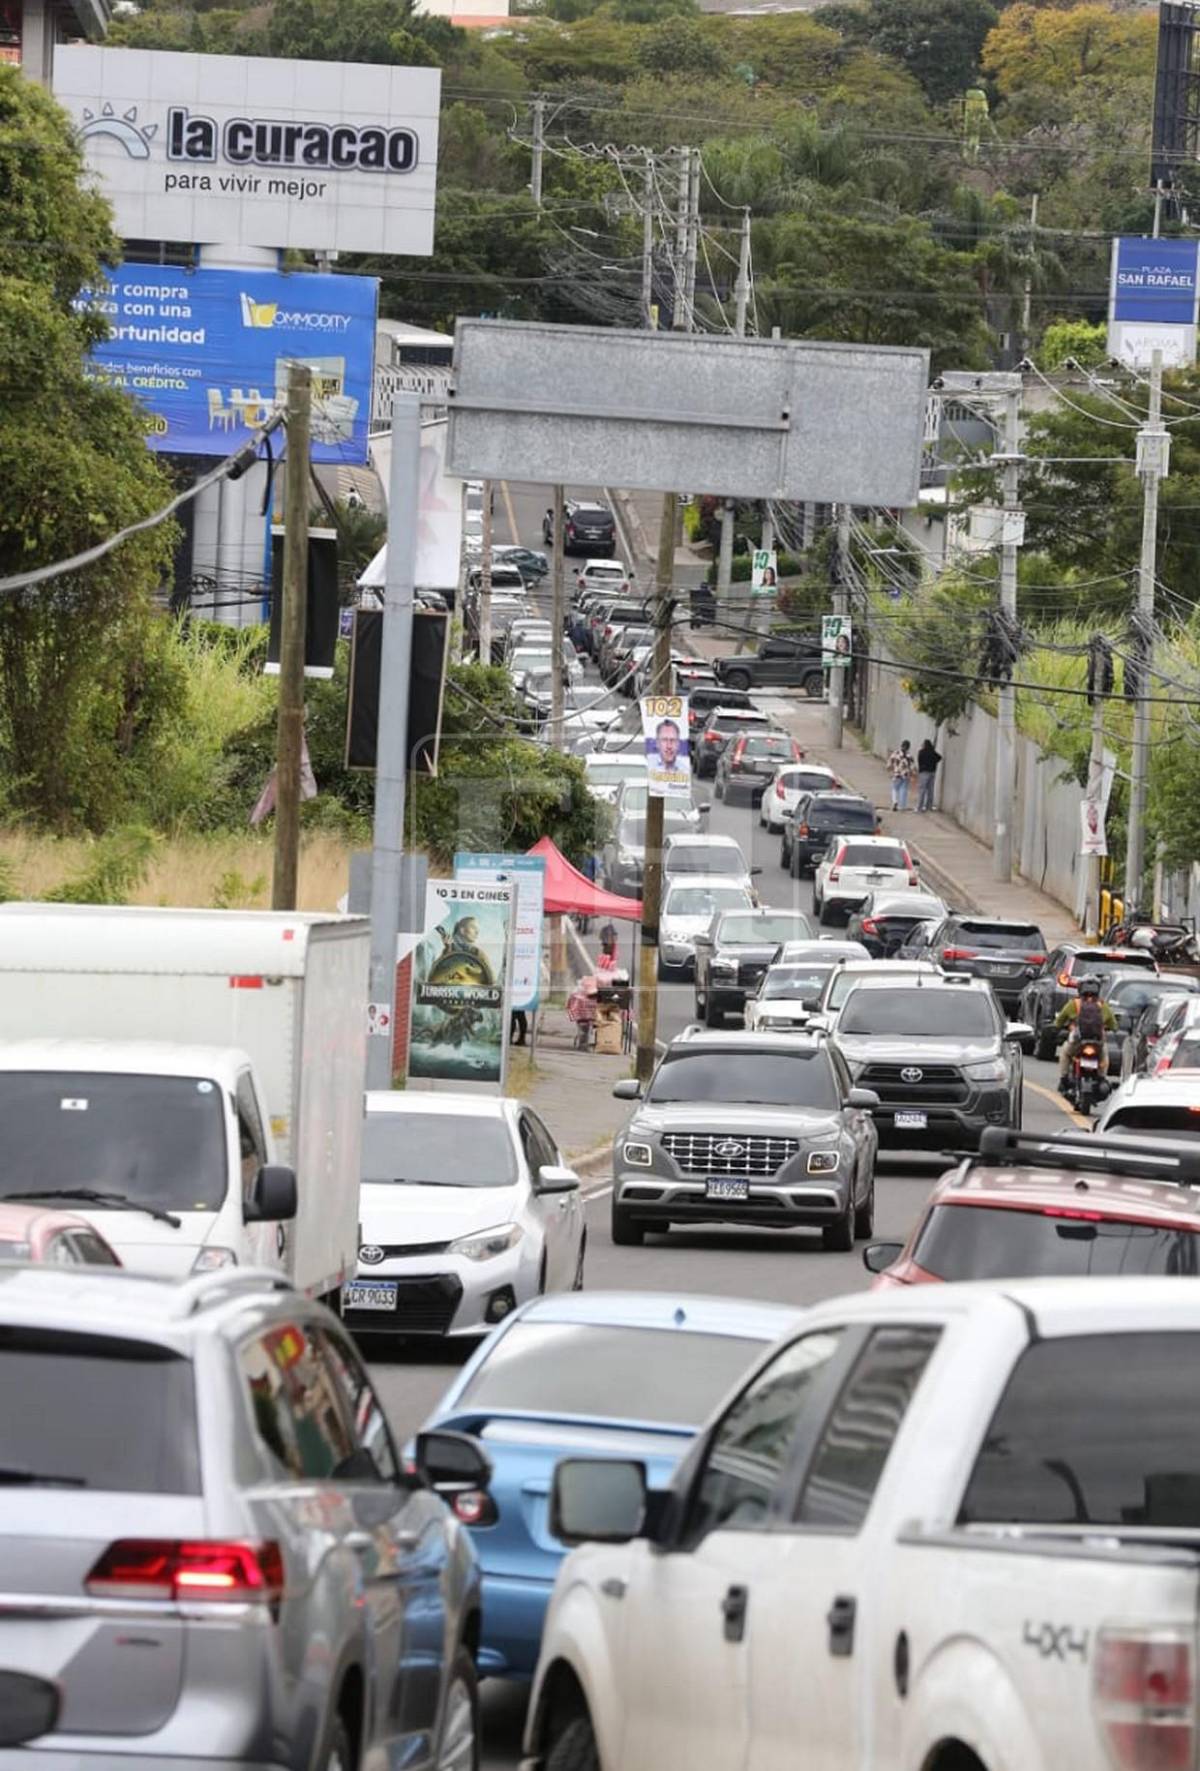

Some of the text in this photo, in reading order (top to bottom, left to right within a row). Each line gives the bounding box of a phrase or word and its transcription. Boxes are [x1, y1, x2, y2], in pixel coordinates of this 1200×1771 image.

[169, 108, 417, 172] la curacao
[165, 172, 327, 200] para vivir mejor
[1141, 266, 1172, 274] PLAZA
[1118, 274, 1194, 287] SAN RAFAEL
[123, 284, 188, 301] compra
[123, 303, 155, 316] con
[159, 305, 192, 318] una
[645, 697, 683, 717] 102
[461, 890, 475, 900] EN
[477, 891, 510, 902] CINES
